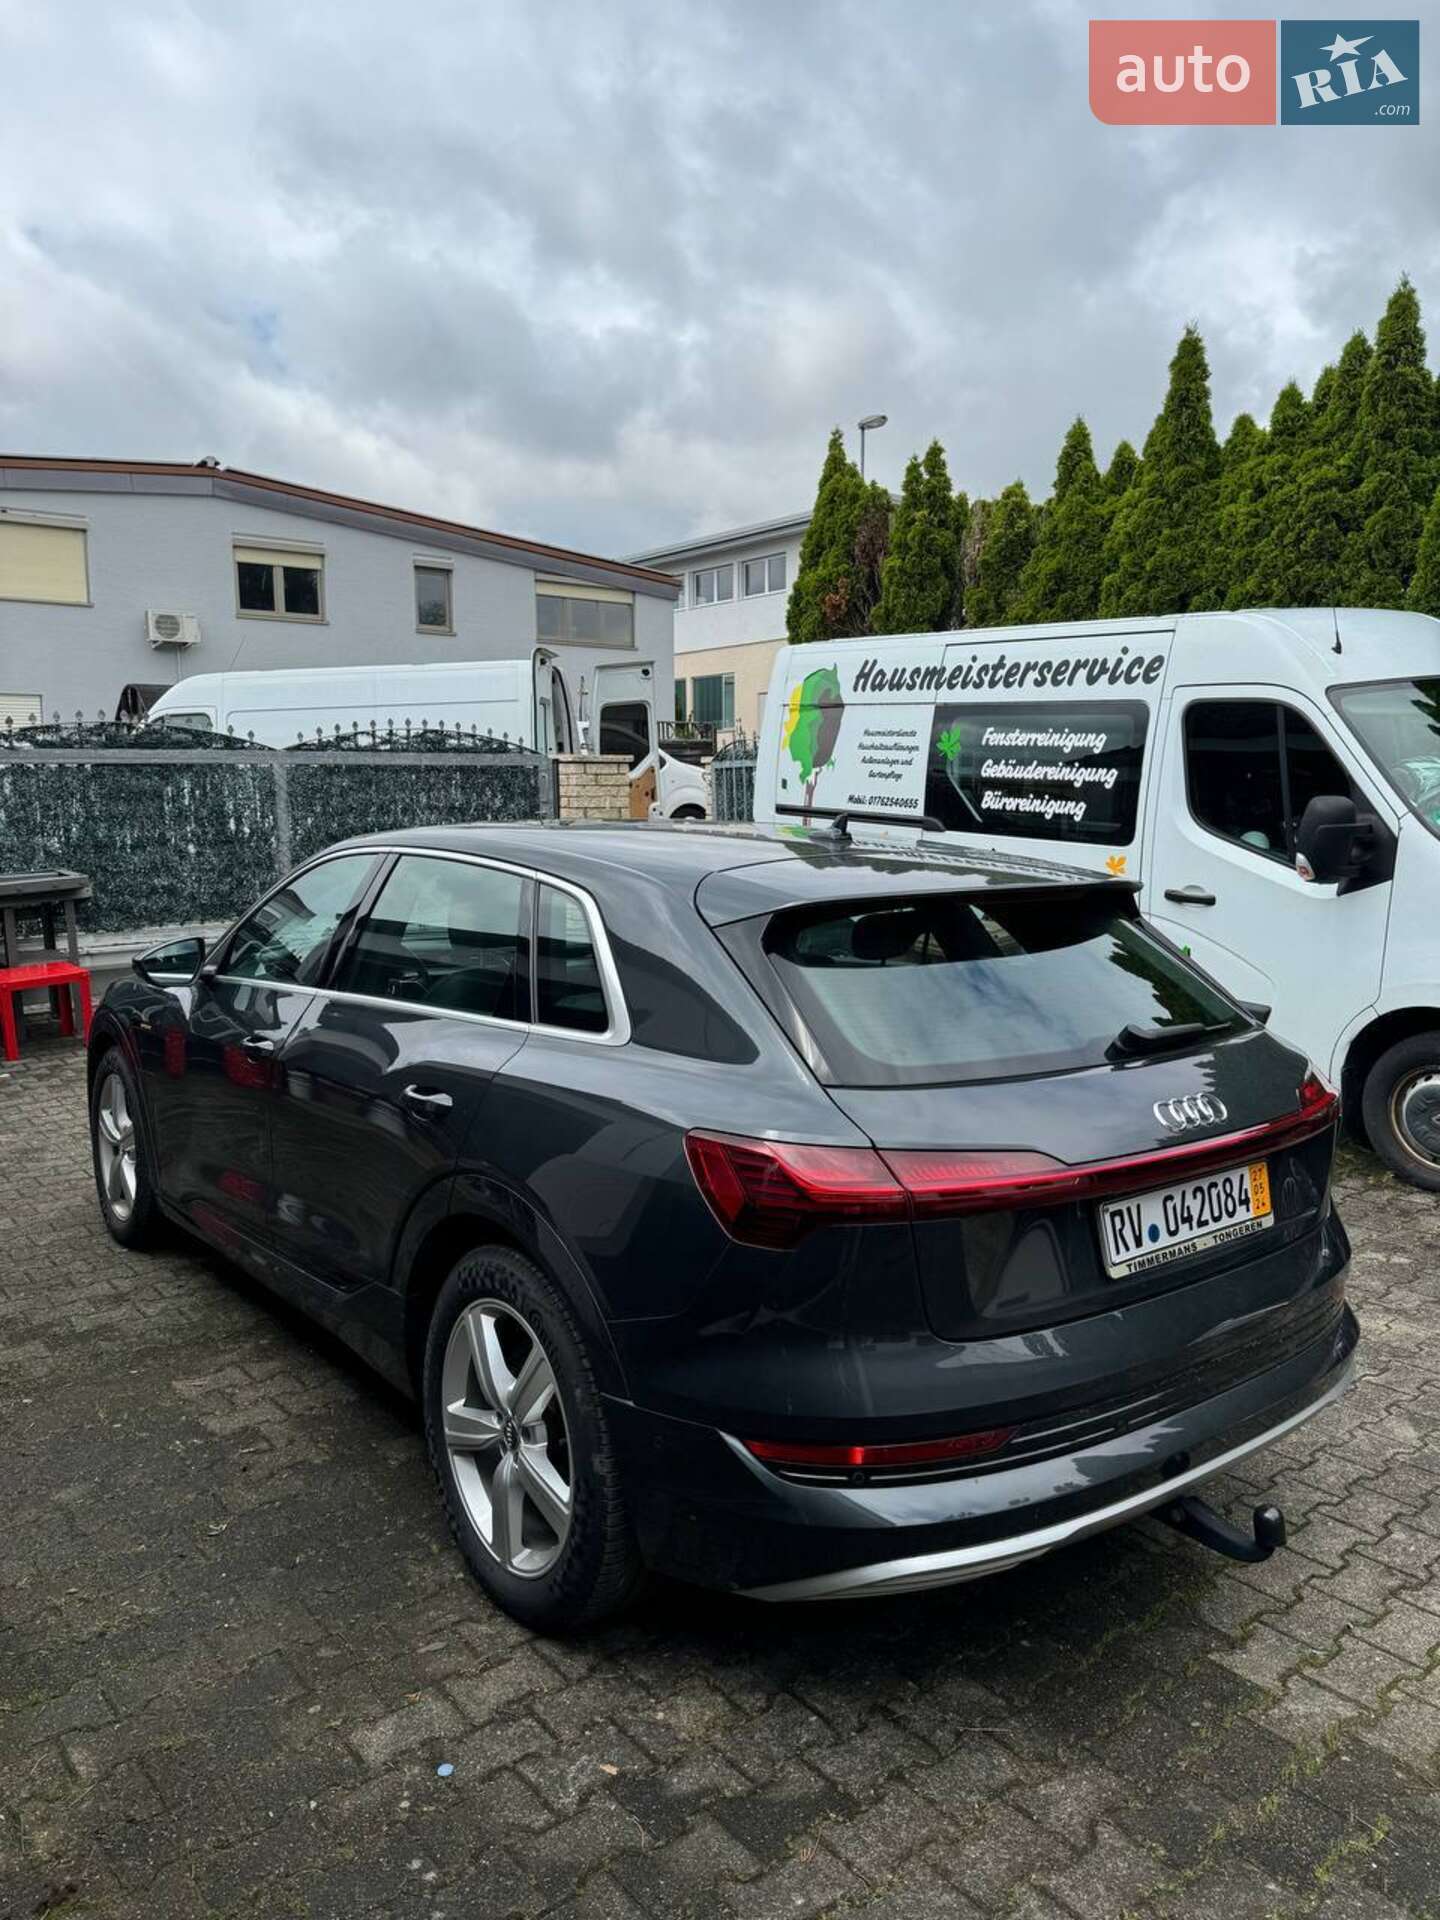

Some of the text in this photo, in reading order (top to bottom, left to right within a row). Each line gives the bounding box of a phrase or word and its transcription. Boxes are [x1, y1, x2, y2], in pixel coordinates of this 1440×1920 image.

[852, 645, 1166, 693] Hausmeisterservice
[981, 727, 1107, 754] Fensterreinigung
[900, 757, 914, 766] und
[980, 759, 1119, 789] Gebäudereinigung
[981, 790, 1087, 822] Büroreinigung
[1109, 1173, 1250, 1255] RV 042084
[1126, 1242, 1198, 1273] TIMMERMANS
[1213, 1220, 1263, 1244] TONGEREN
